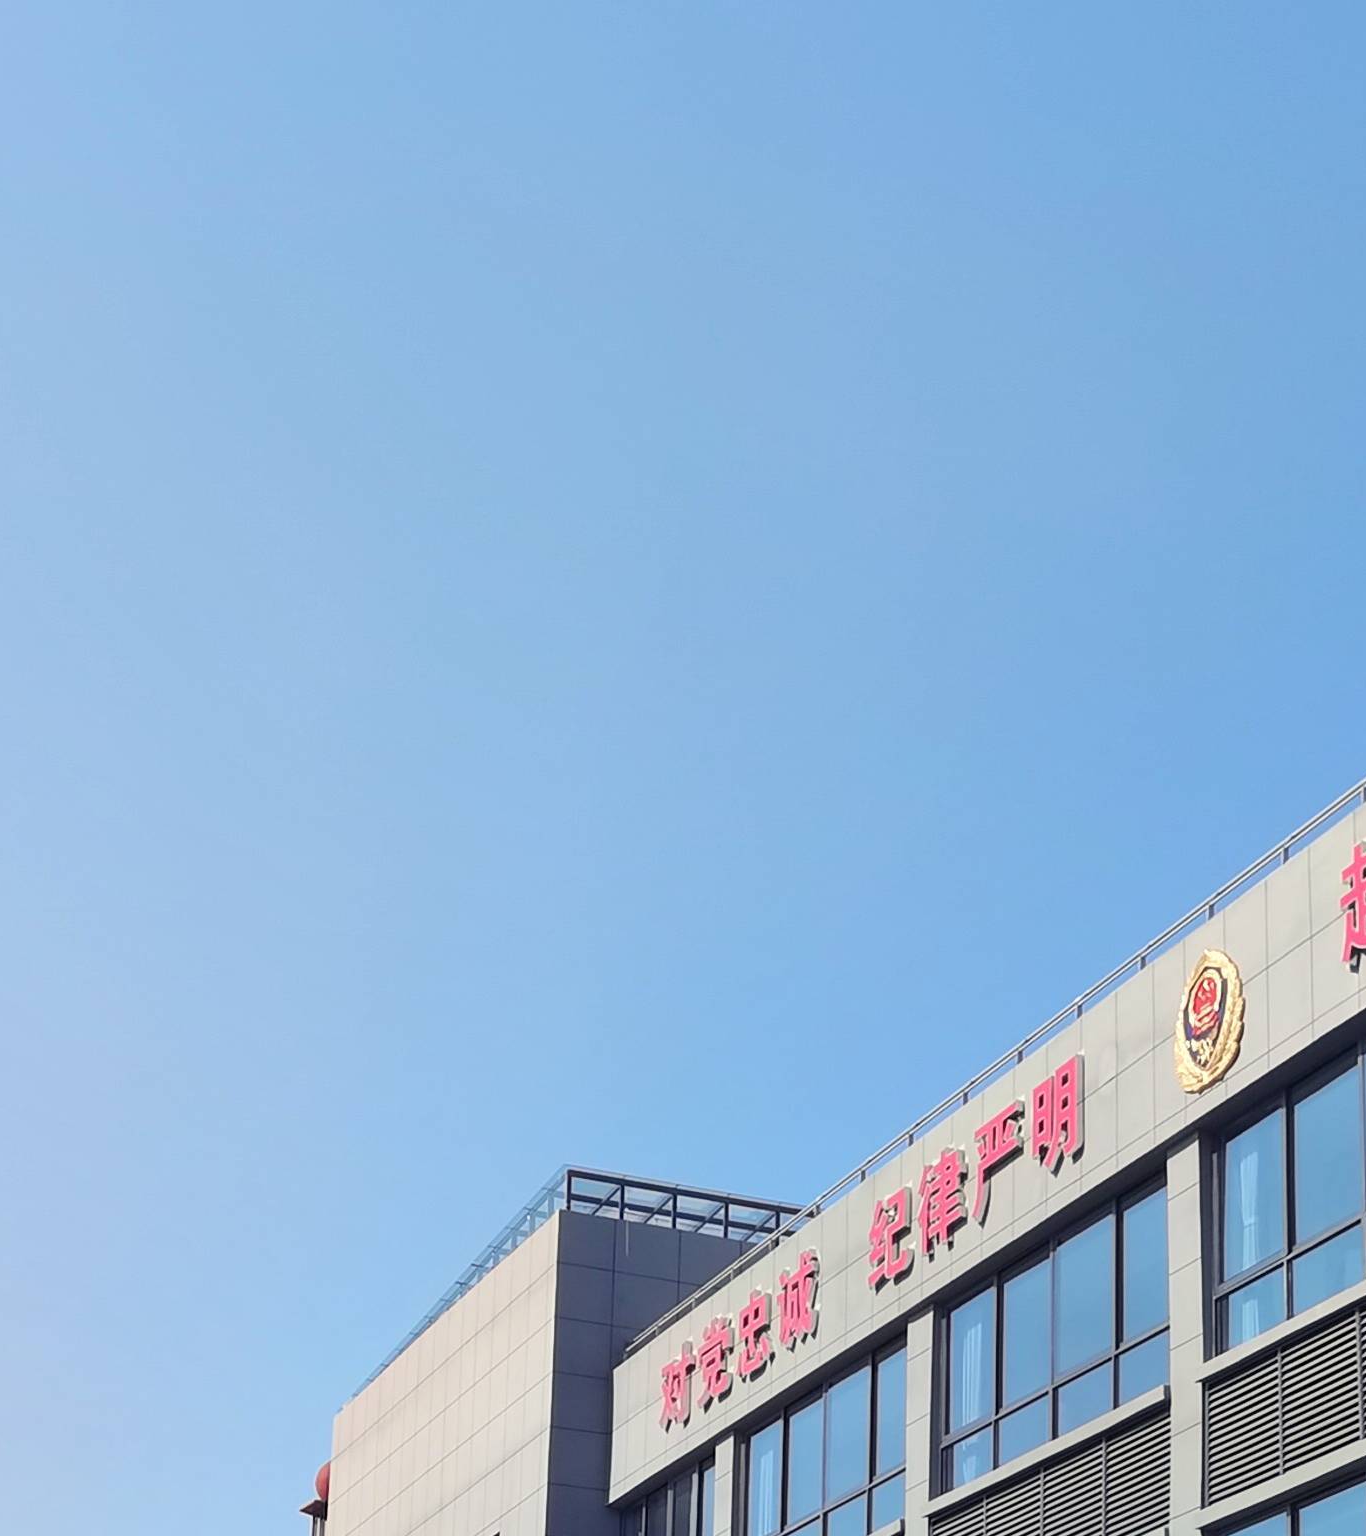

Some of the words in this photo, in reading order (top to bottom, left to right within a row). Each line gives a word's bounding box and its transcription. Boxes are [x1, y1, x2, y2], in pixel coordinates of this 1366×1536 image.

[657, 1247, 822, 1428] 对党忠诚
[865, 1052, 1085, 1290] 纪律严明
